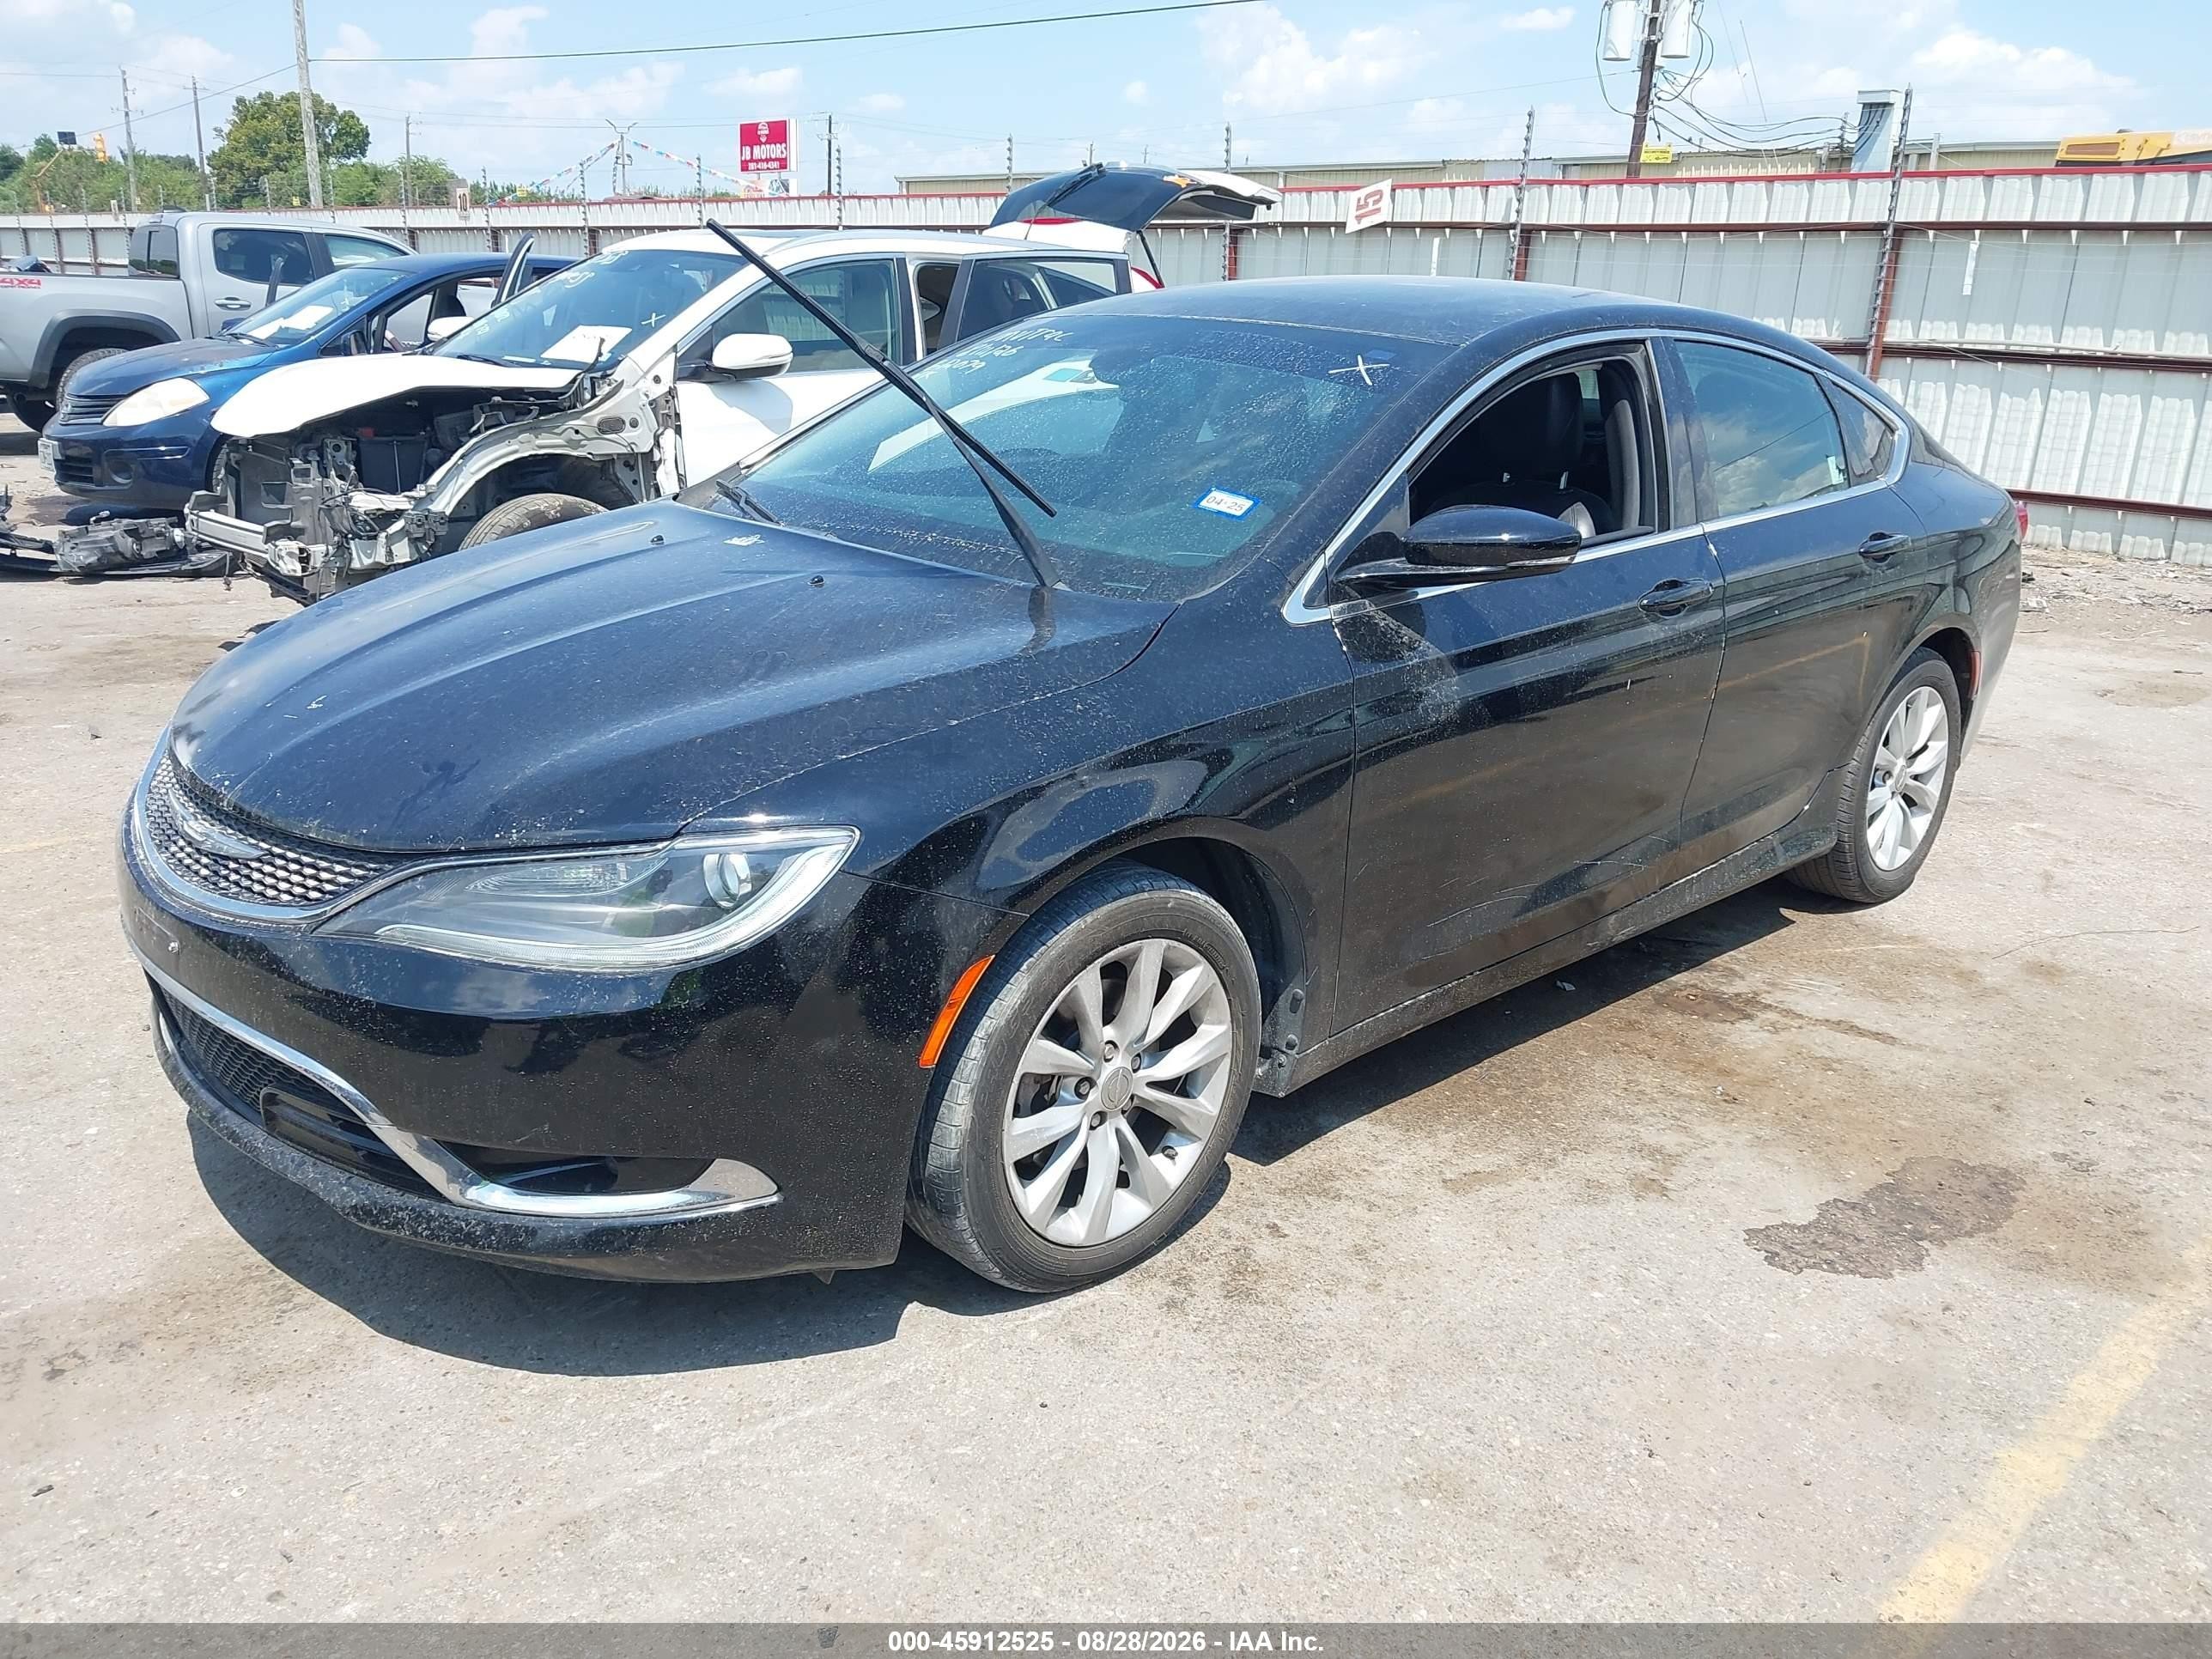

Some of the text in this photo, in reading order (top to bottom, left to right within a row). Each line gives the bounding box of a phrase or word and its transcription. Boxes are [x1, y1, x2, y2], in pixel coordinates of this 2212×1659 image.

[742, 143, 787, 161] JB MOTORS
[458, 192, 467, 212] 10
